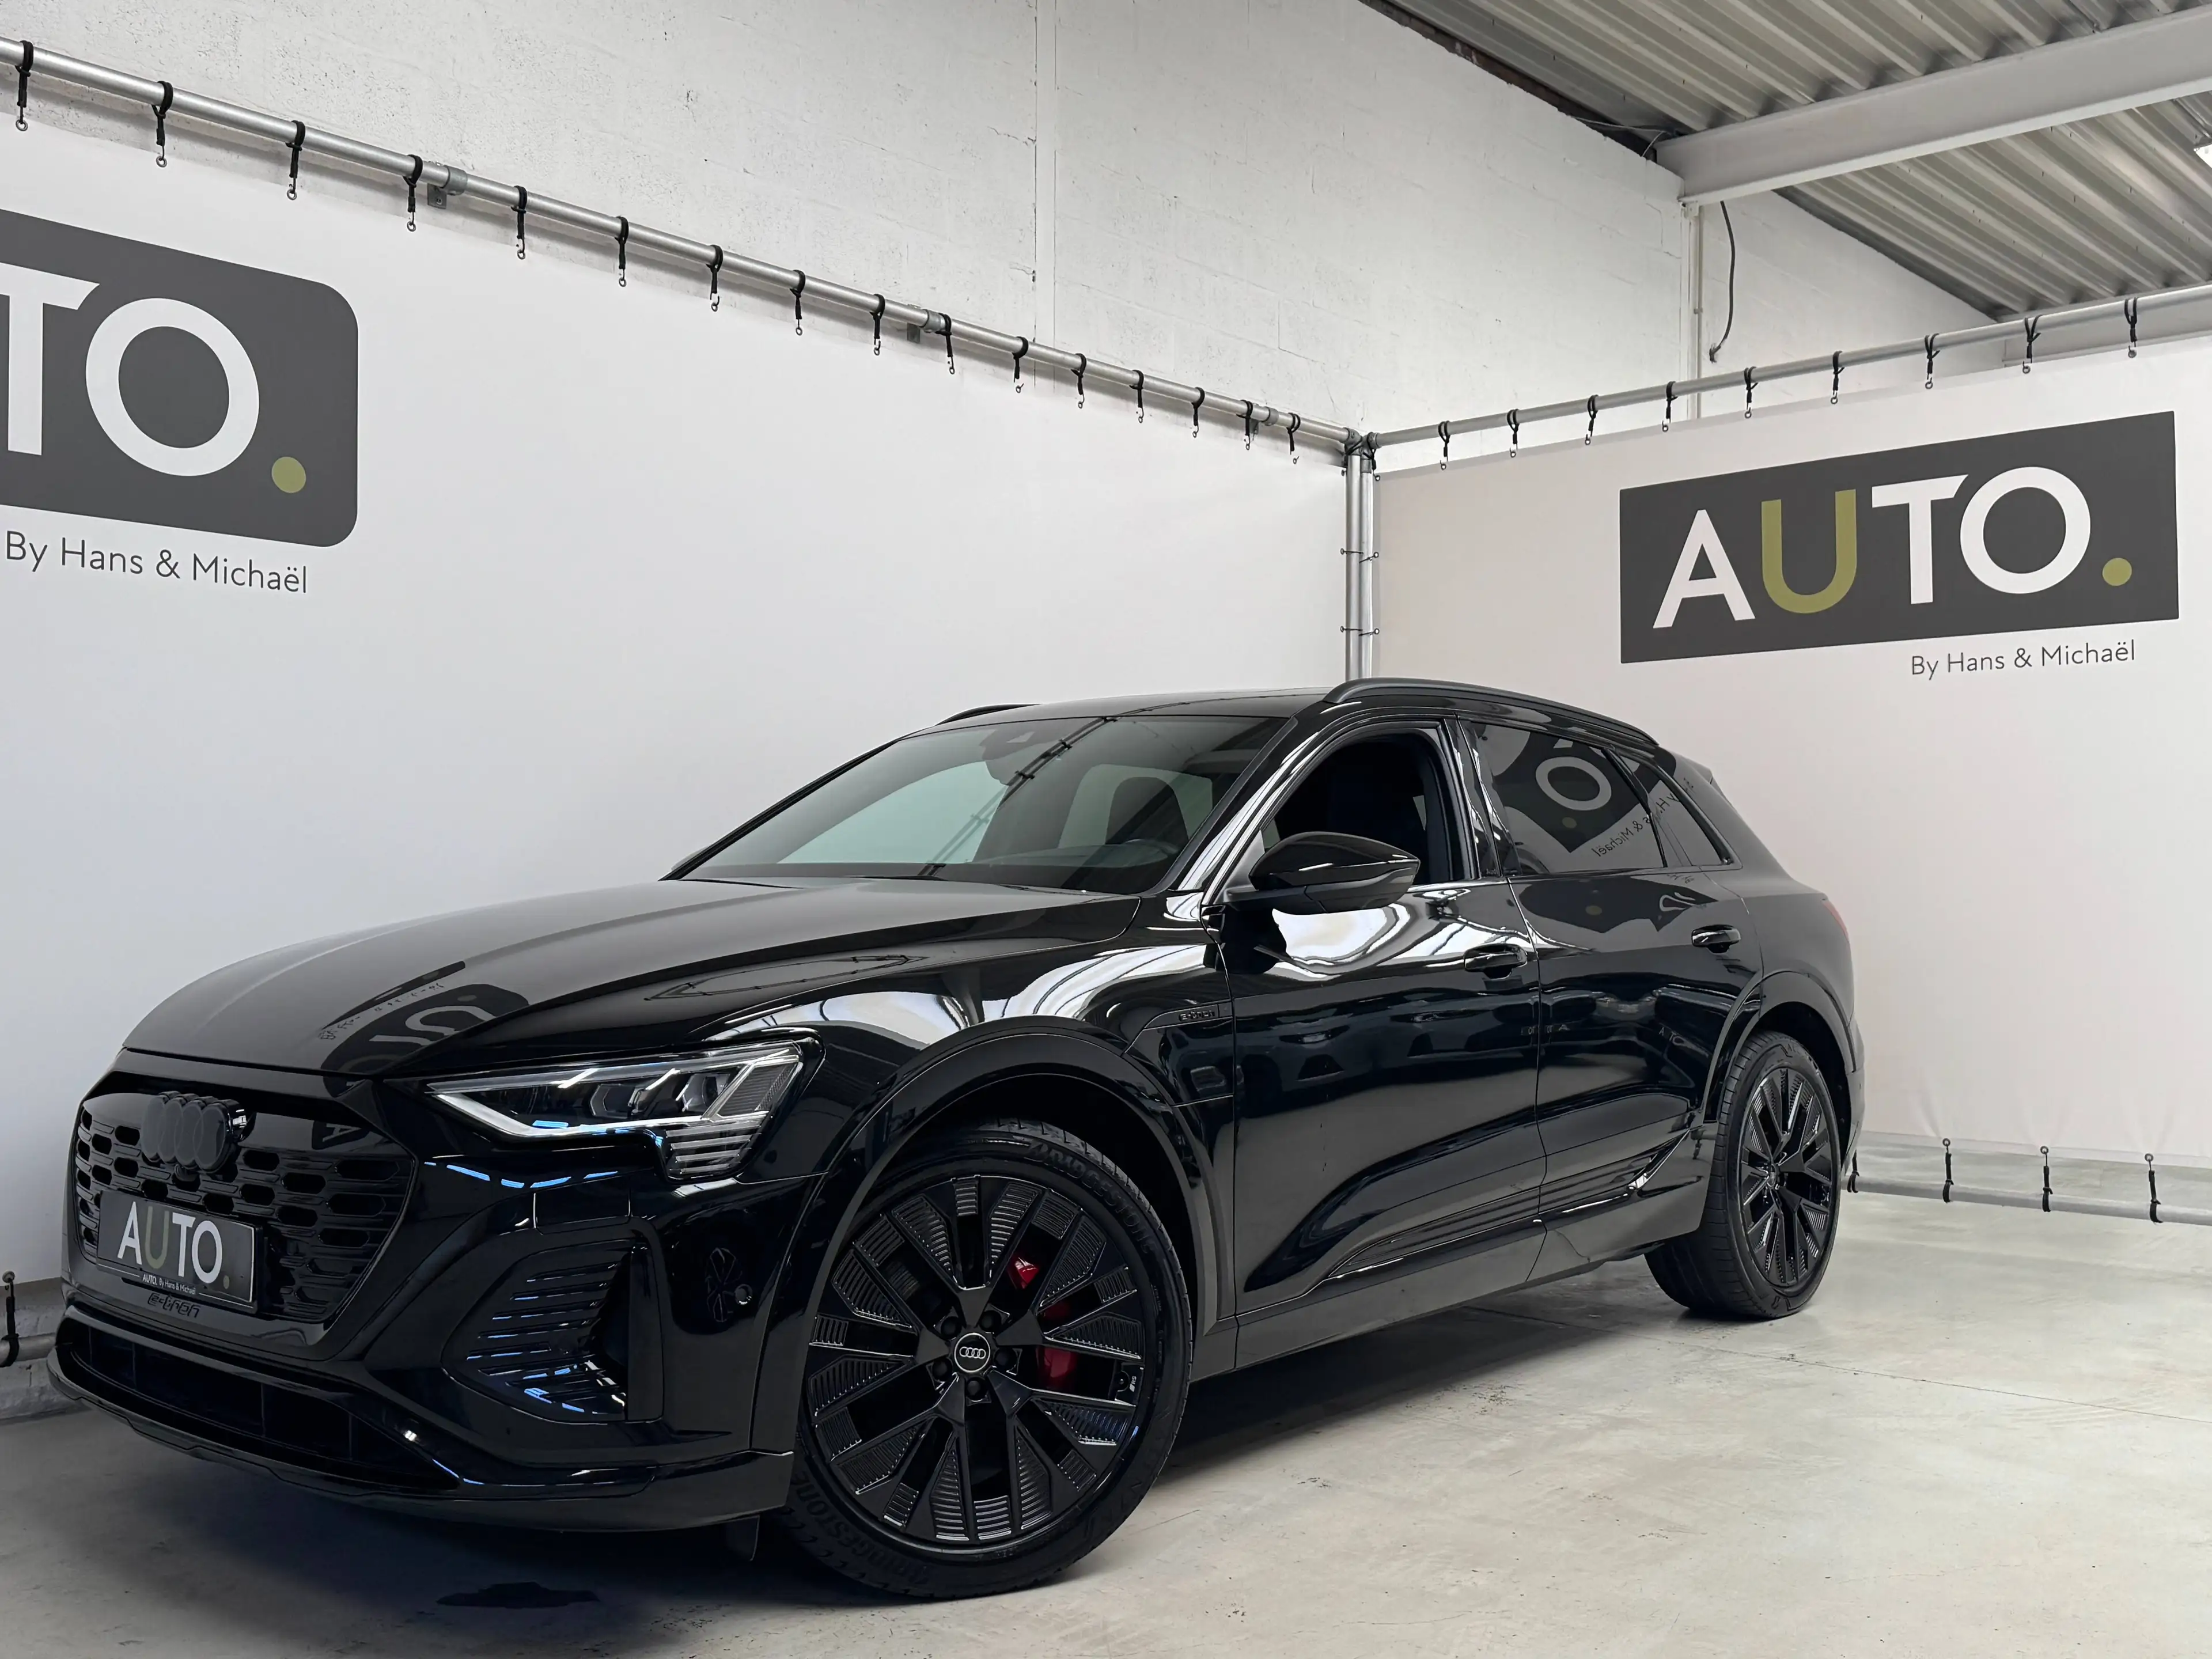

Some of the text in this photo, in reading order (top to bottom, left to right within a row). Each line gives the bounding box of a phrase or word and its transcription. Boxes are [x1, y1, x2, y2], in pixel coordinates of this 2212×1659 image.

[6, 530, 306, 593] By Hans & Michaël
[1652, 466, 2133, 629] AUTO.
[1912, 639, 2134, 680] By Hans & Michaël
[117, 1200, 230, 1289] AUTO.
[142, 1274, 157, 1286] AUTO.
[159, 1277, 164, 1289] By
[165, 1279, 175, 1290] Hans
[176, 1282, 180, 1291] &
[147, 1292, 200, 1318] e-tron
